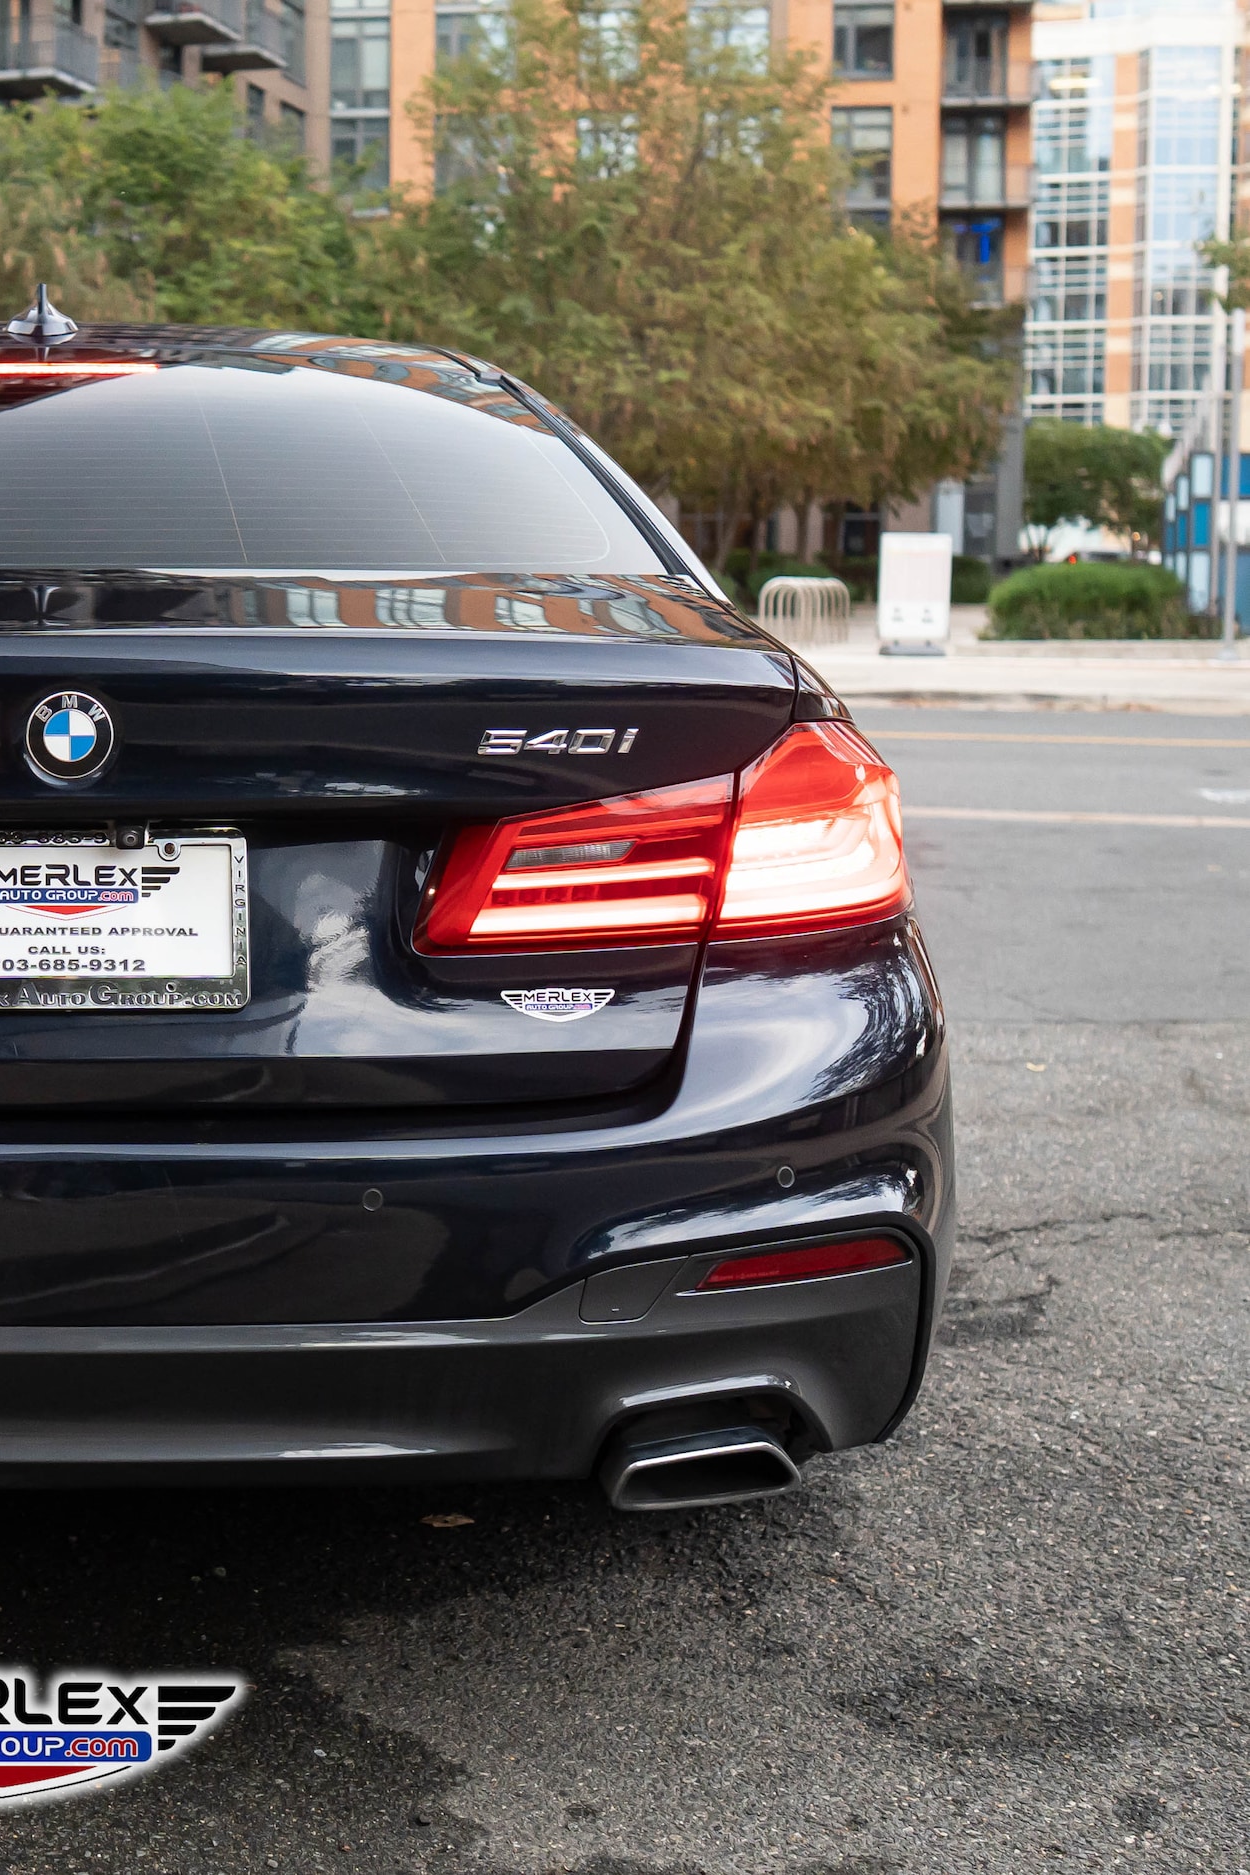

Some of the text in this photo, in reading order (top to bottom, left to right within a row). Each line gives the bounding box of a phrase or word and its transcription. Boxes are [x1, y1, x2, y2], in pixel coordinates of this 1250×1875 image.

[35, 694, 105, 722] BMW
[477, 728, 639, 754] 540i
[0, 889, 41, 901] AUTO
[233, 855, 247, 967] VIRGINIA
[108, 927, 199, 937] APPROVAL
[28, 946, 106, 955] CALL US:
[523, 991, 591, 1002] MERLEX
